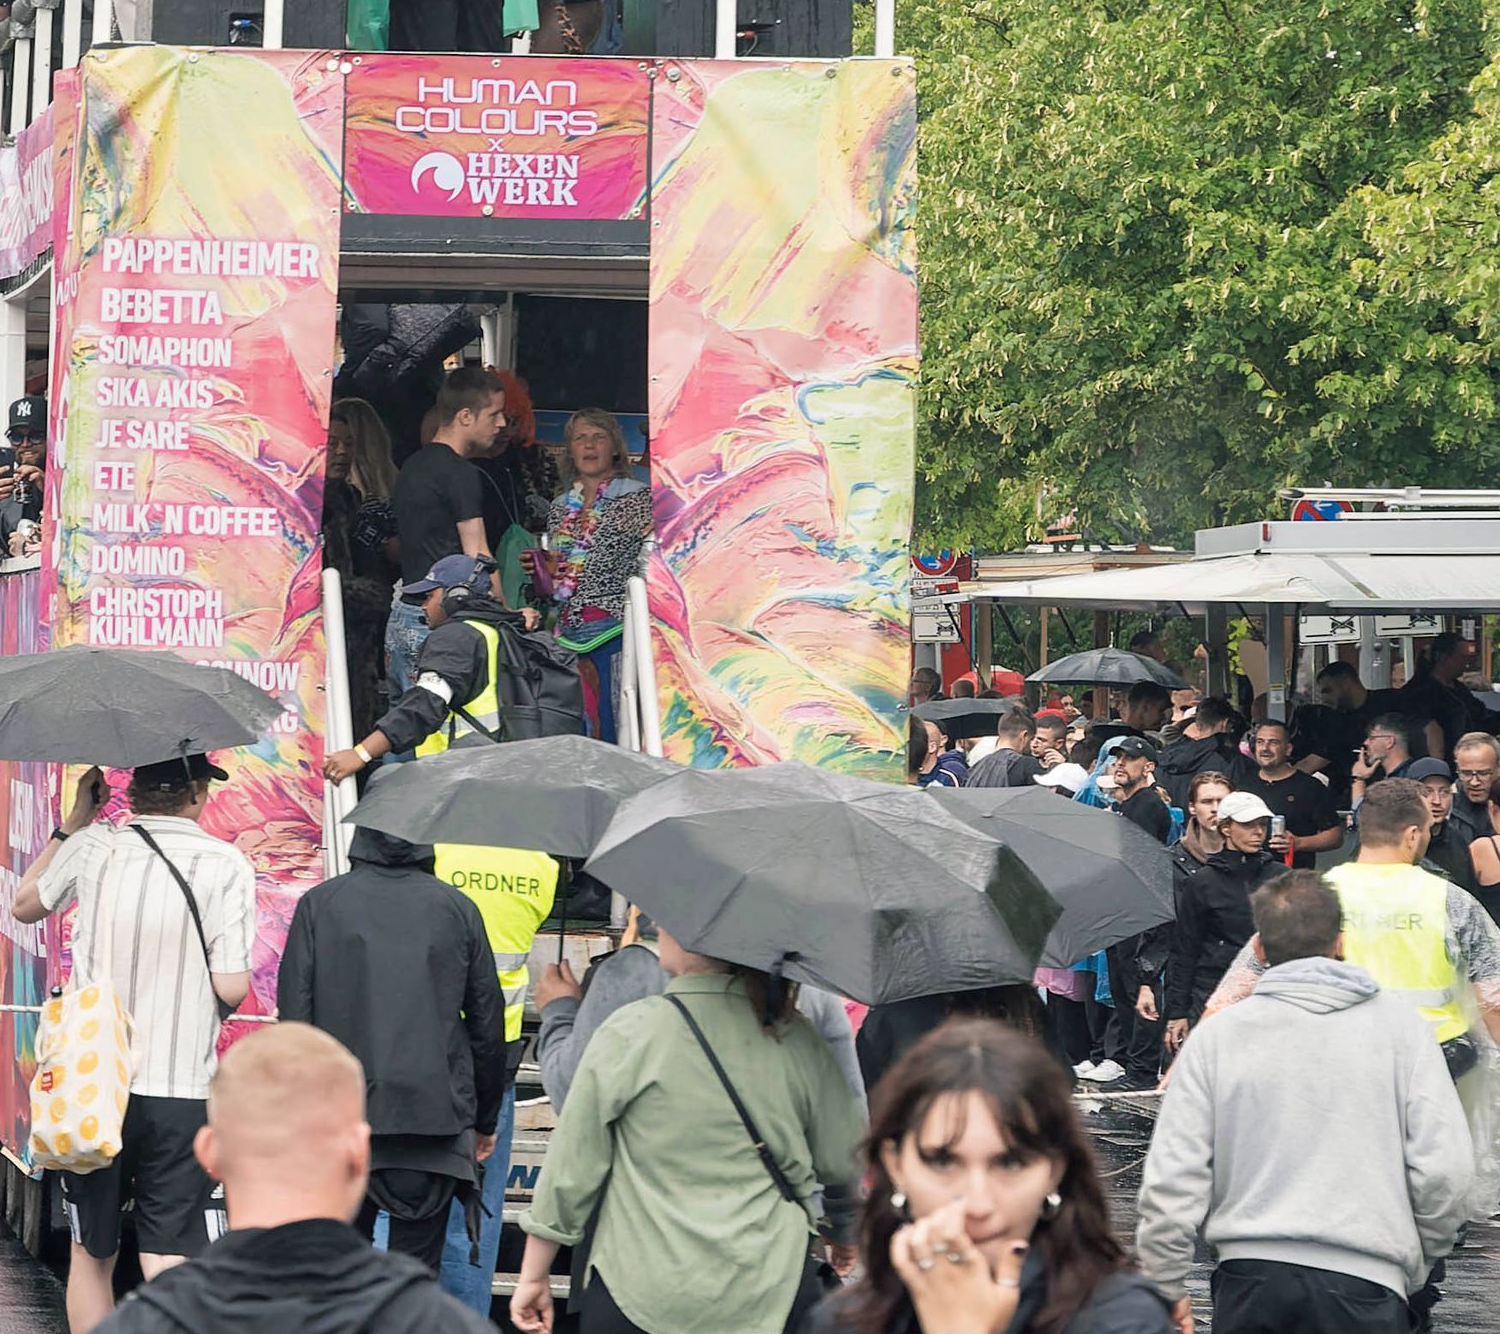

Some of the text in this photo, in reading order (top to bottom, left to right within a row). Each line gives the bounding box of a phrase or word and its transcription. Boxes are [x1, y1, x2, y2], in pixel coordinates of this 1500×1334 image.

[418, 77, 577, 106] HUMAN
[395, 106, 598, 136] COLOURS
[466, 153, 580, 179] HEXEN
[466, 177, 579, 206] WERK
[102, 238, 320, 278] PAPPENHEIMER
[101, 288, 223, 325] BEBETTA
[98, 336, 232, 367] SOMAPHON
[97, 378, 214, 409] SIKA AKIS
[96, 413, 190, 451] JE SARÉ
[94, 461, 136, 491] ETE
[93, 503, 150, 533] MILK
[188, 506, 278, 537] COFFEE
[92, 546, 186, 576] DOMINO
[90, 587, 223, 618] CHRISTOPH
[451, 870, 540, 898] ORDNER
